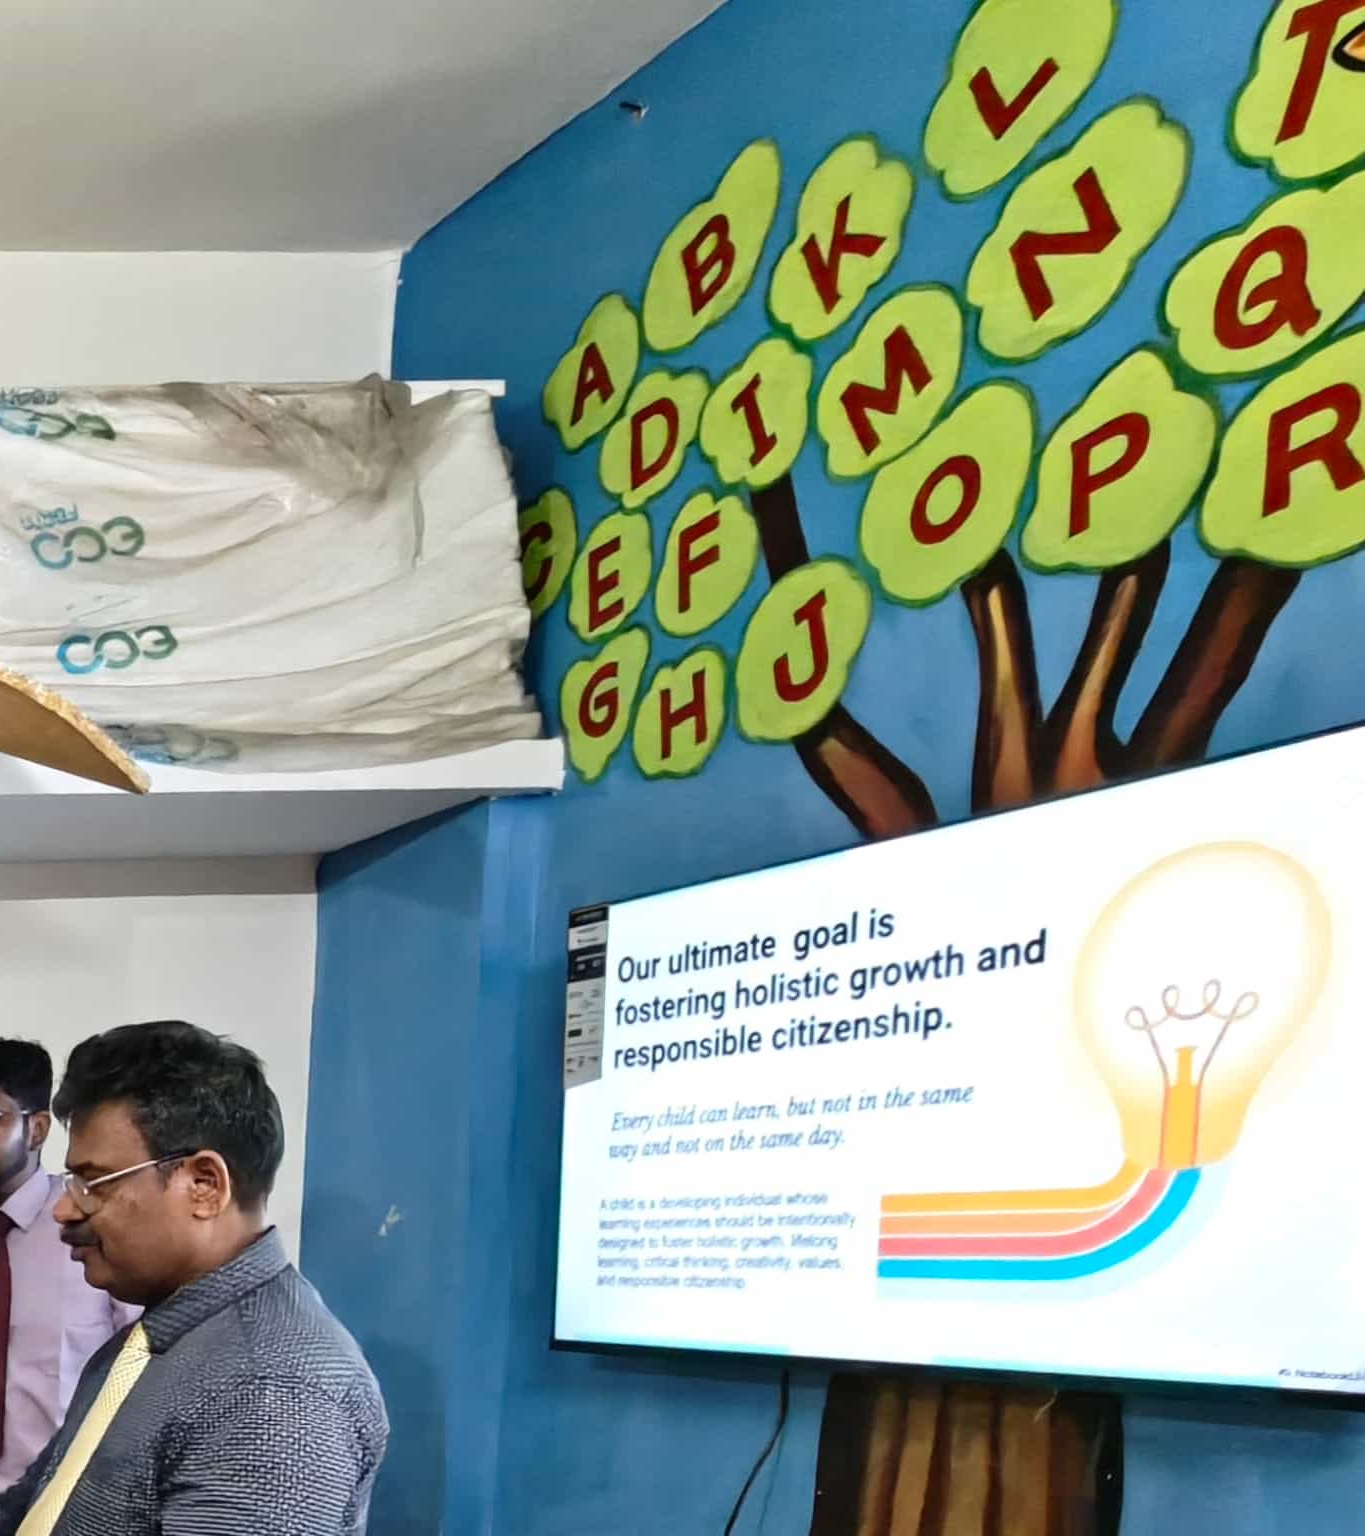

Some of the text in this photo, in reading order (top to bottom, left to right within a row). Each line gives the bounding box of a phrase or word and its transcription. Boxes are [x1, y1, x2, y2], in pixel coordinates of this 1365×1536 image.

[969, 58, 1059, 140] L
[681, 214, 737, 317] B
[801, 196, 886, 314] K
[1009, 168, 1122, 322] N
[1212, 224, 1322, 351] Q
[570, 342, 615, 427] A
[730, 372, 778, 468] I
[841, 325, 933, 455] M
[630, 396, 680, 491] D
[1068, 411, 1151, 539] P
[1261, 382, 1365, 519] R
[910, 454, 982, 546] O
[587, 535, 624, 633] E
[676, 509, 721, 614] F
[772, 590, 829, 703] J
[578, 660, 619, 738] G
[659, 668, 708, 760] H
[614, 926, 1048, 1026] fostering holistic growth and
[617, 907, 896, 983] Our ultimate goal is
[613, 1023, 763, 1073] responsible
[771, 1000, 954, 1049] citizenship.
[608, 1123, 846, 1164] way and not on the same day.
[611, 1085, 976, 1134] Every child can learn, but not in the same
